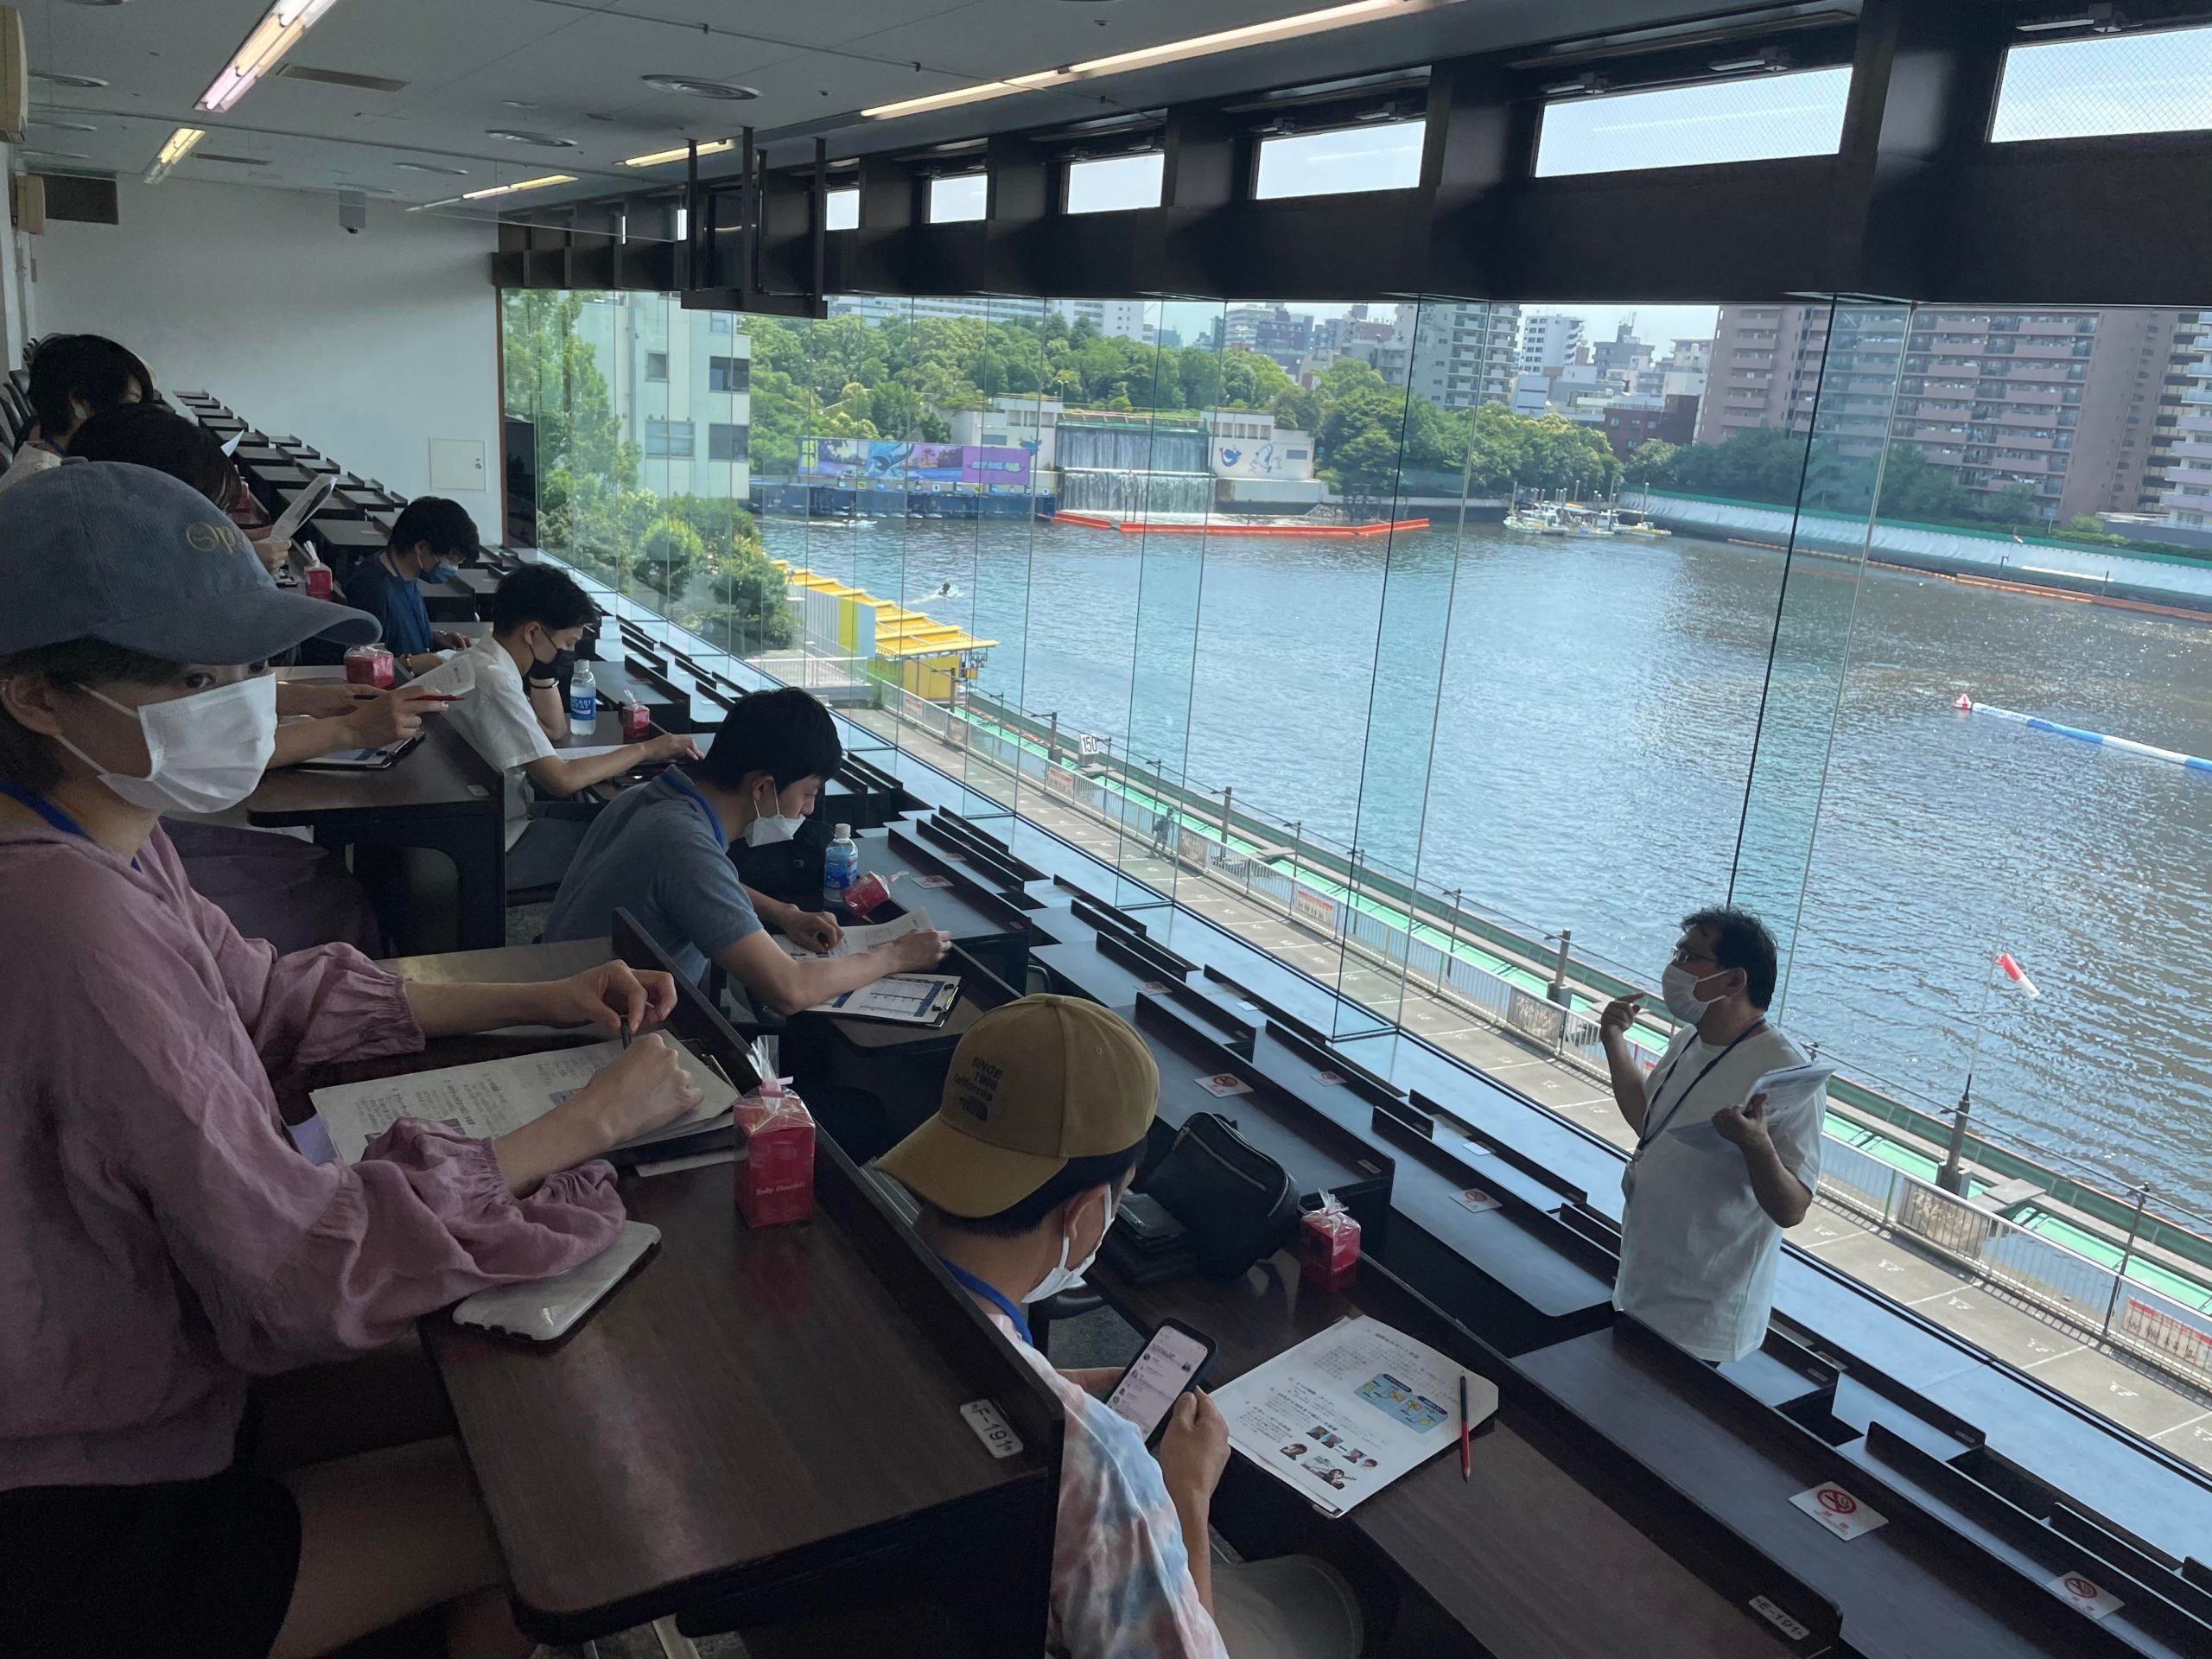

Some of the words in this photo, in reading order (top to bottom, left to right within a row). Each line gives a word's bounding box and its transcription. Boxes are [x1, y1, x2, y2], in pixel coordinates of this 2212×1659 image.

[1082, 736, 1097, 753] 150
[970, 1056, 1003, 1080] SINCE
[970, 1406, 1014, 1449] F-191
[1758, 1602, 1800, 1633] E-191
